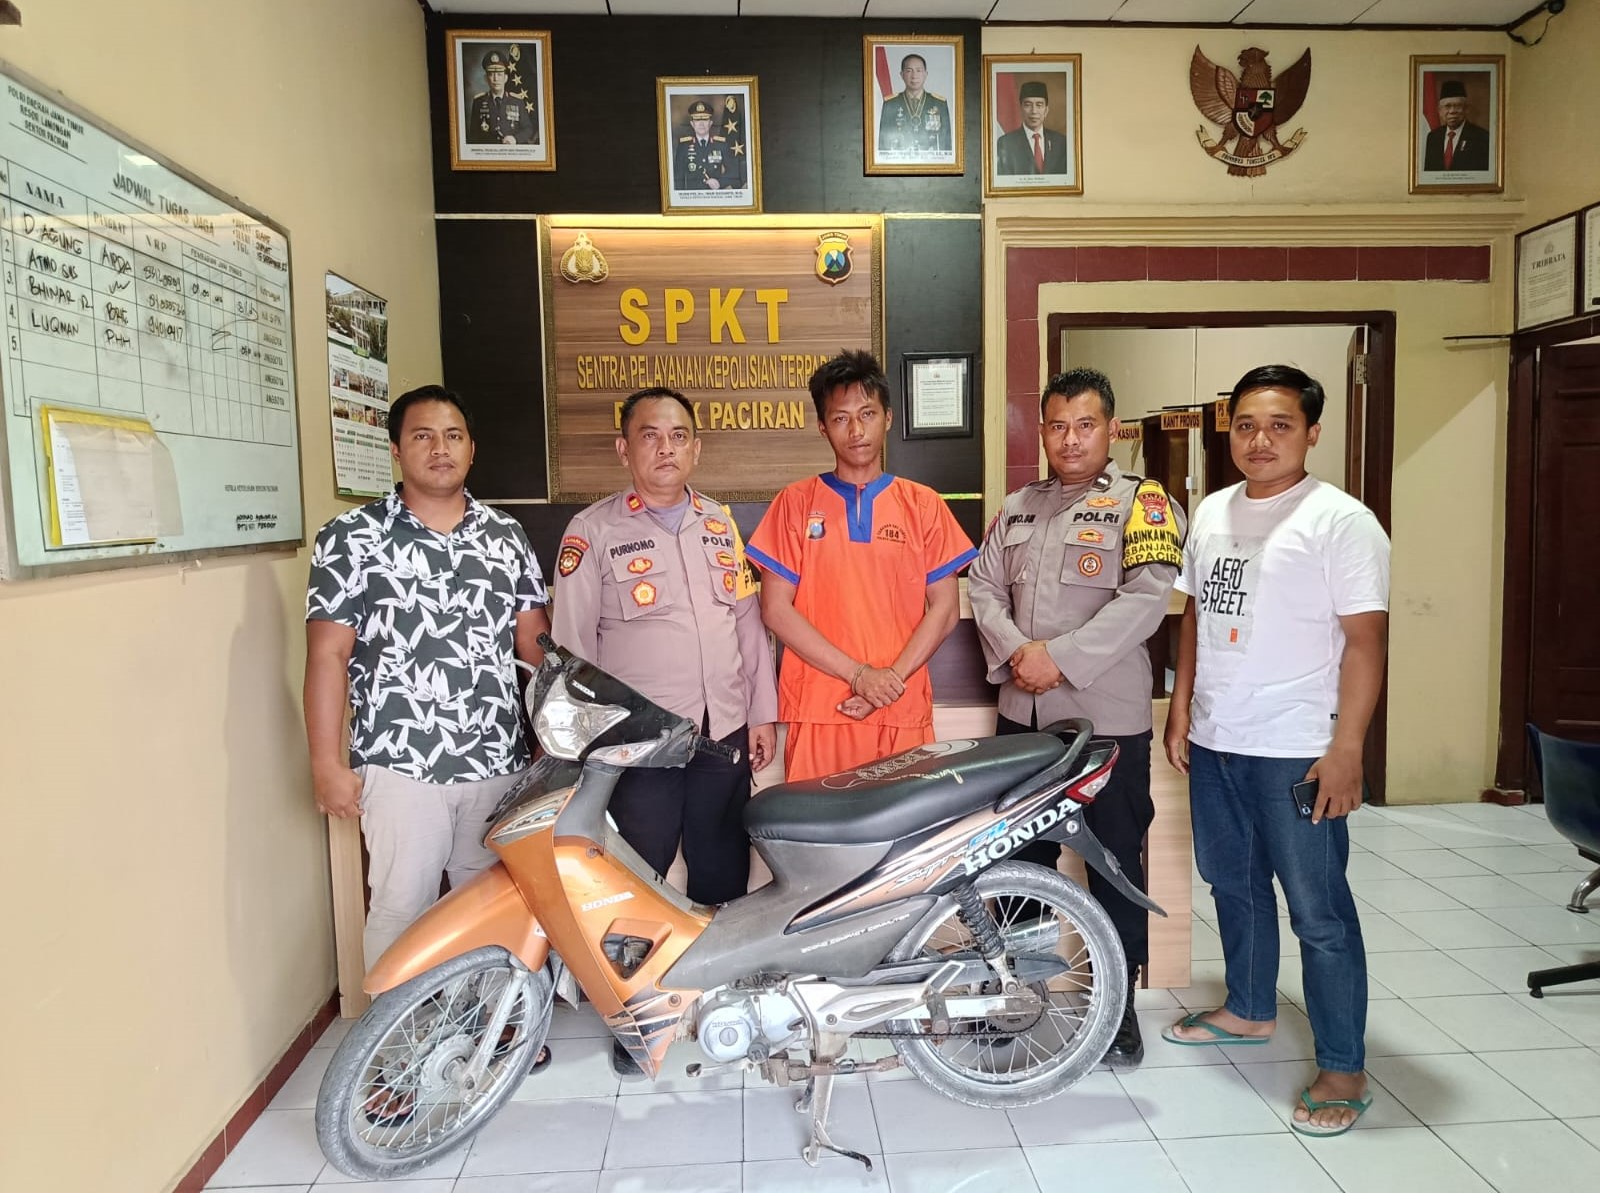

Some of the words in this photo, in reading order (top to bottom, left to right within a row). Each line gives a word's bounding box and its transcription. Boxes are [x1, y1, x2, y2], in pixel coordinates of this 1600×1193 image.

[25, 181, 64, 209] NAMA
[113, 172, 155, 206] JADWAL
[158, 195, 189, 224] TUGAS
[192, 217, 214, 237] JAGA
[1532, 252, 1566, 271] TRIBRATA
[28, 275, 75, 304] BHINAR
[31, 308, 79, 338] LUQMAN
[619, 287, 790, 345] SPKT
[577, 355, 628, 390] SENTRA
[630, 355, 701, 390] PELAYANAN
[705, 354, 778, 390] KEPOLISIAN
[780, 354, 835, 389] TERPA
[709, 400, 806, 430] PACIRAN
[1073, 512, 1120, 524] POLRI
[885, 529, 900, 539] 184
[610, 539, 655, 559] PURNOMO
[962, 798, 1082, 876] HONDA
